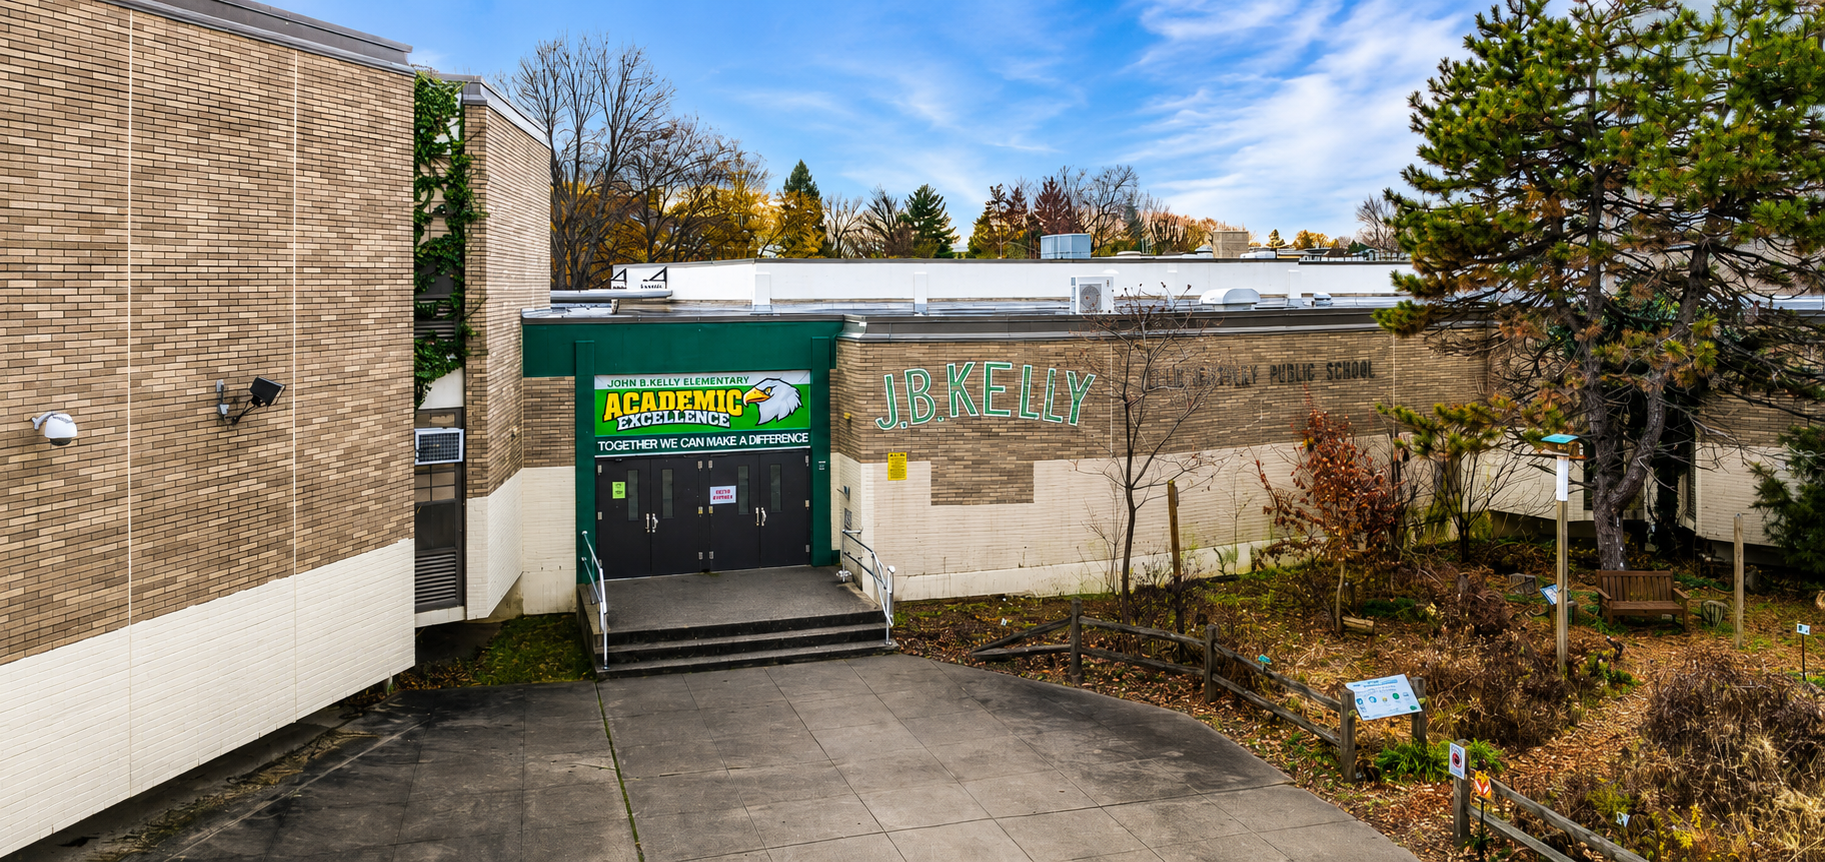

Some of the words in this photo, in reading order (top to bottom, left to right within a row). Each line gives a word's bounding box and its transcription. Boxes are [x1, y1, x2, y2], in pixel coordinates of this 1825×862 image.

[607, 379, 636, 388] JOHN
[683, 376, 749, 386] ELEMENTARY
[1270, 363, 1315, 384] PUBLIC
[1326, 361, 1375, 380] SCHOOL
[603, 389, 743, 422] ACADEMIC
[875, 361, 1096, 430] J.B.KELLY
[617, 410, 730, 431] EXCELLENCE
[598, 439, 658, 451] TOGETHER
[659, 438, 678, 449] WE
[680, 437, 705, 448] CAN
[706, 435, 737, 446] MAKE
[739, 435, 747, 445] A
[749, 432, 809, 445] DIFFERENCE
